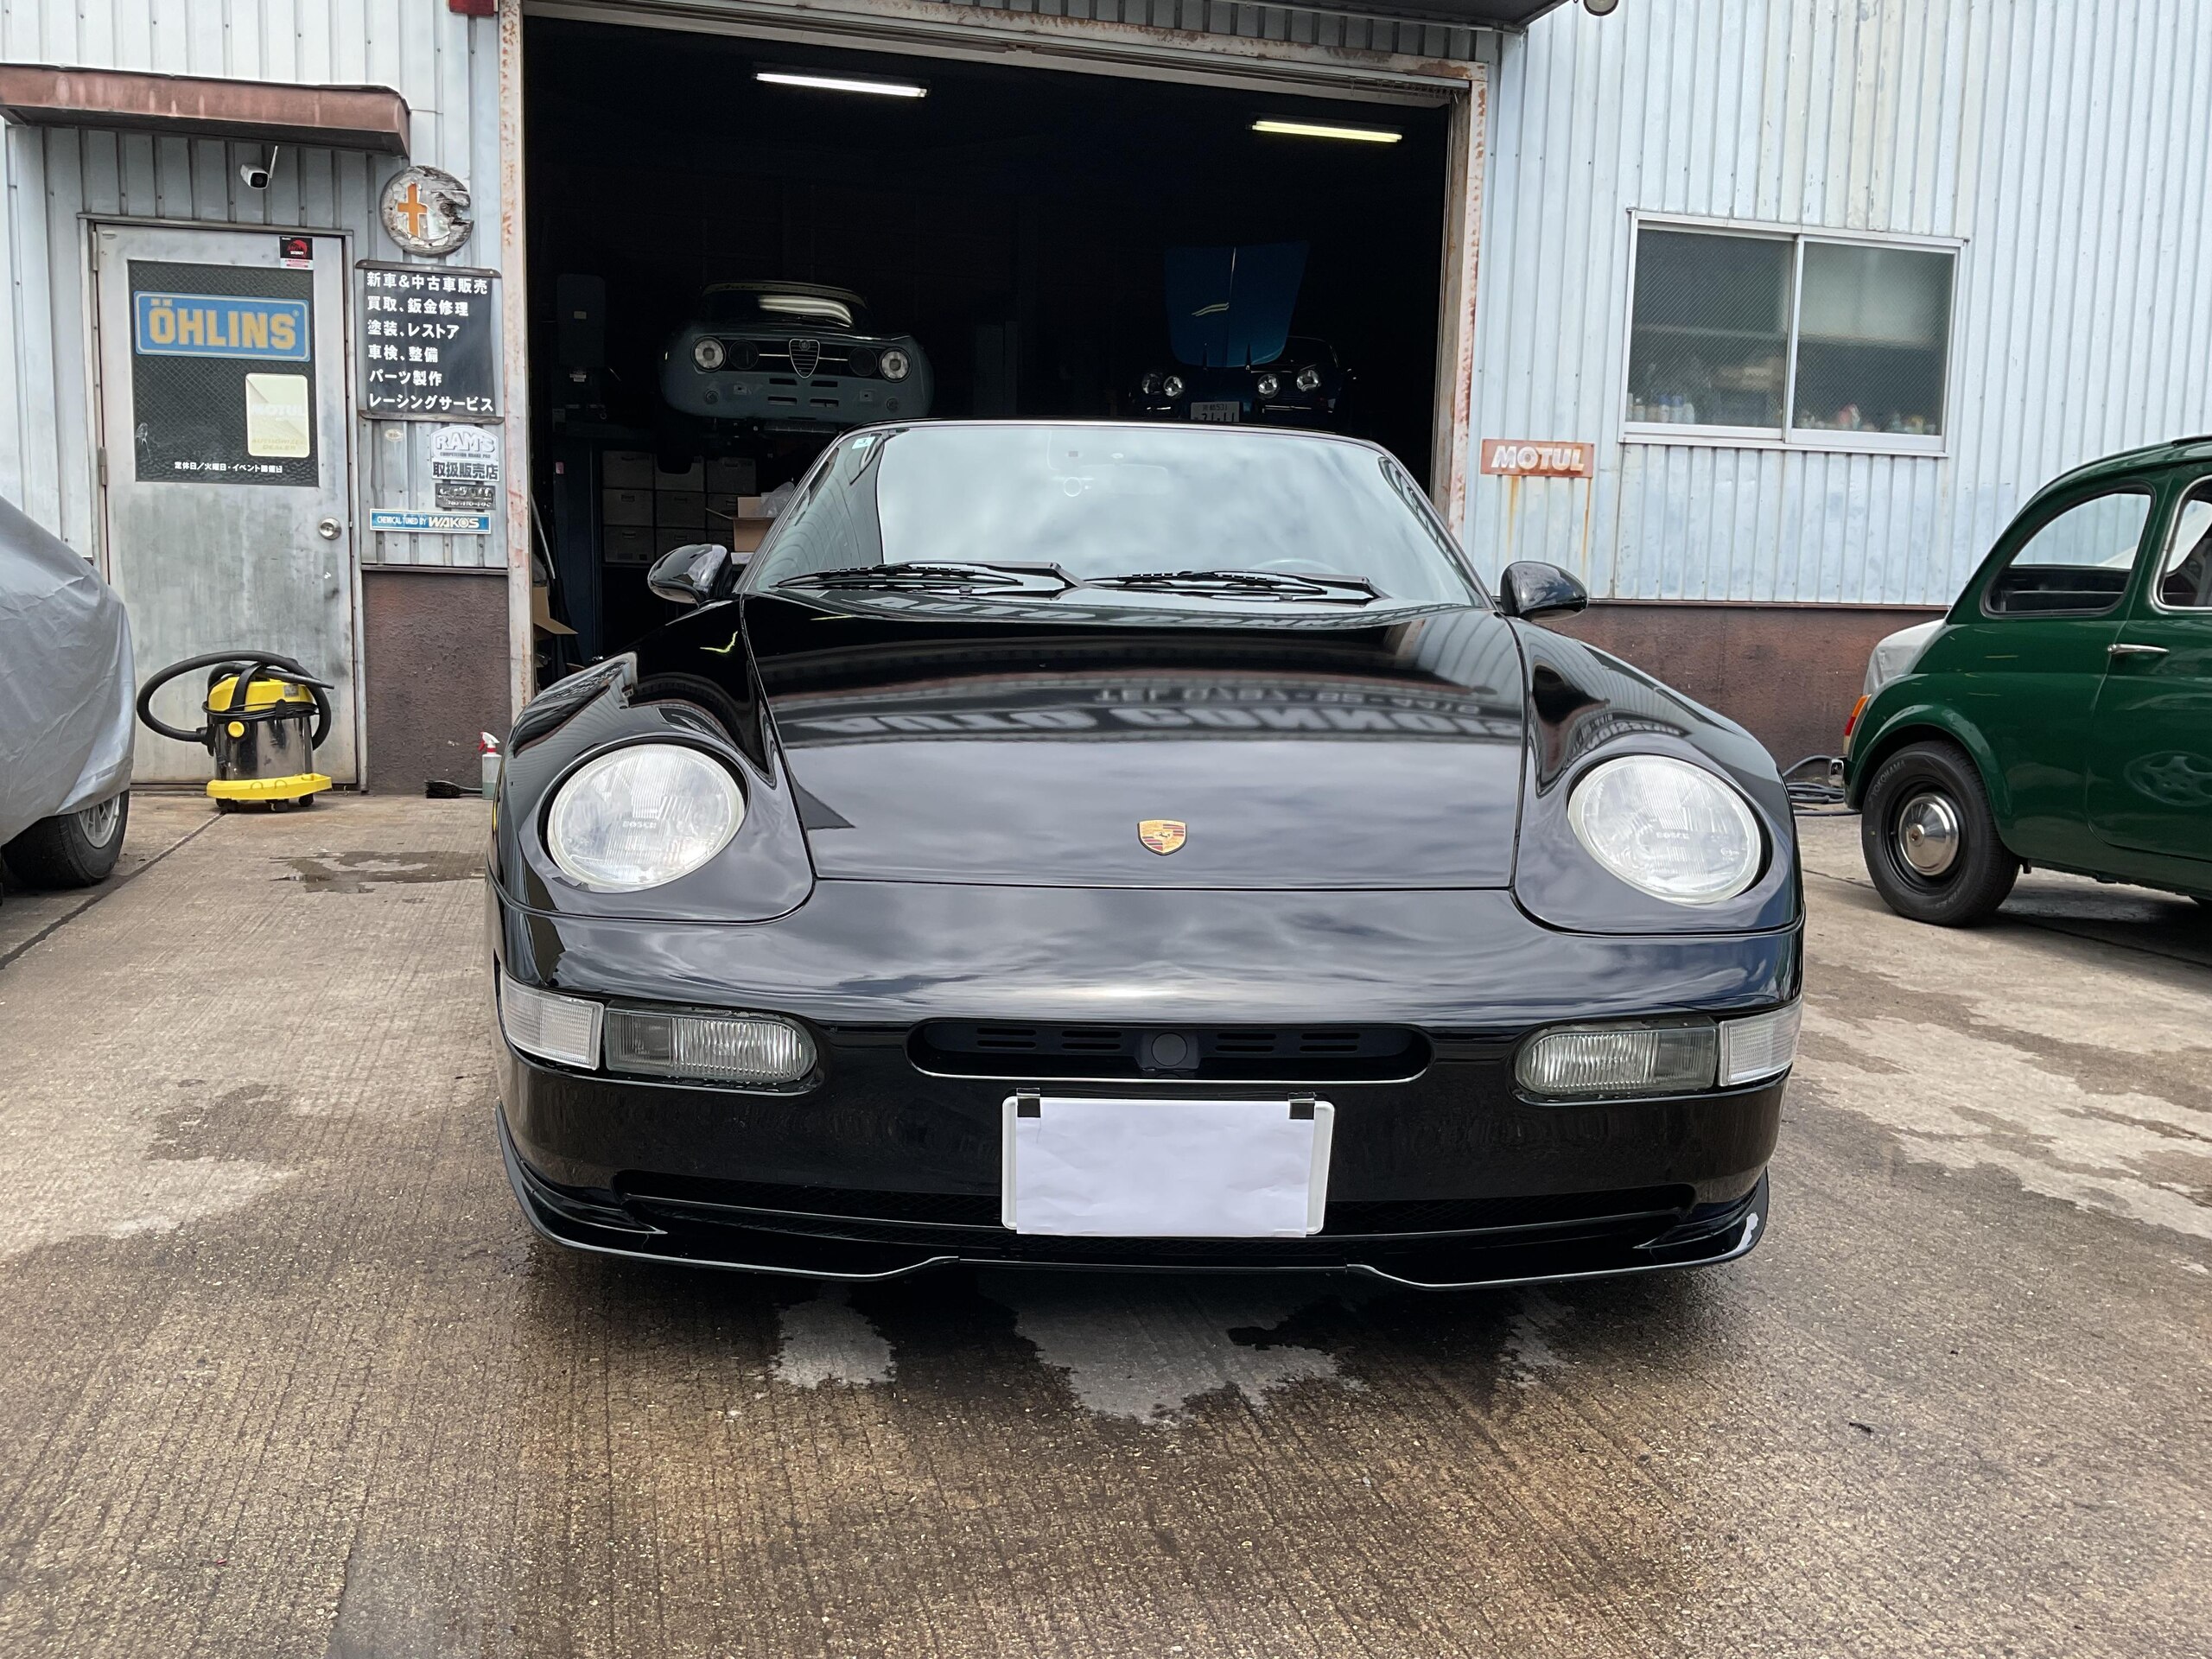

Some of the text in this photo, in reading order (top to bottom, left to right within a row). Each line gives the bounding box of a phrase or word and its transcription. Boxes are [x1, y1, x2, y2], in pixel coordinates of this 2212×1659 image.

[367, 271, 487, 295] 新車&中古車販売
[367, 296, 469, 316] 買取、鈑金修理
[149, 298, 296, 350] ÖHLINS
[367, 319, 460, 339] 塗装、レストア
[368, 344, 439, 363] 車検、整備
[369, 368, 442, 386] パーツ製作
[369, 393, 494, 412] レーシングサービス
[1491, 445, 1585, 472] MOTUL
[432, 461, 499, 480] 取扱販売店
